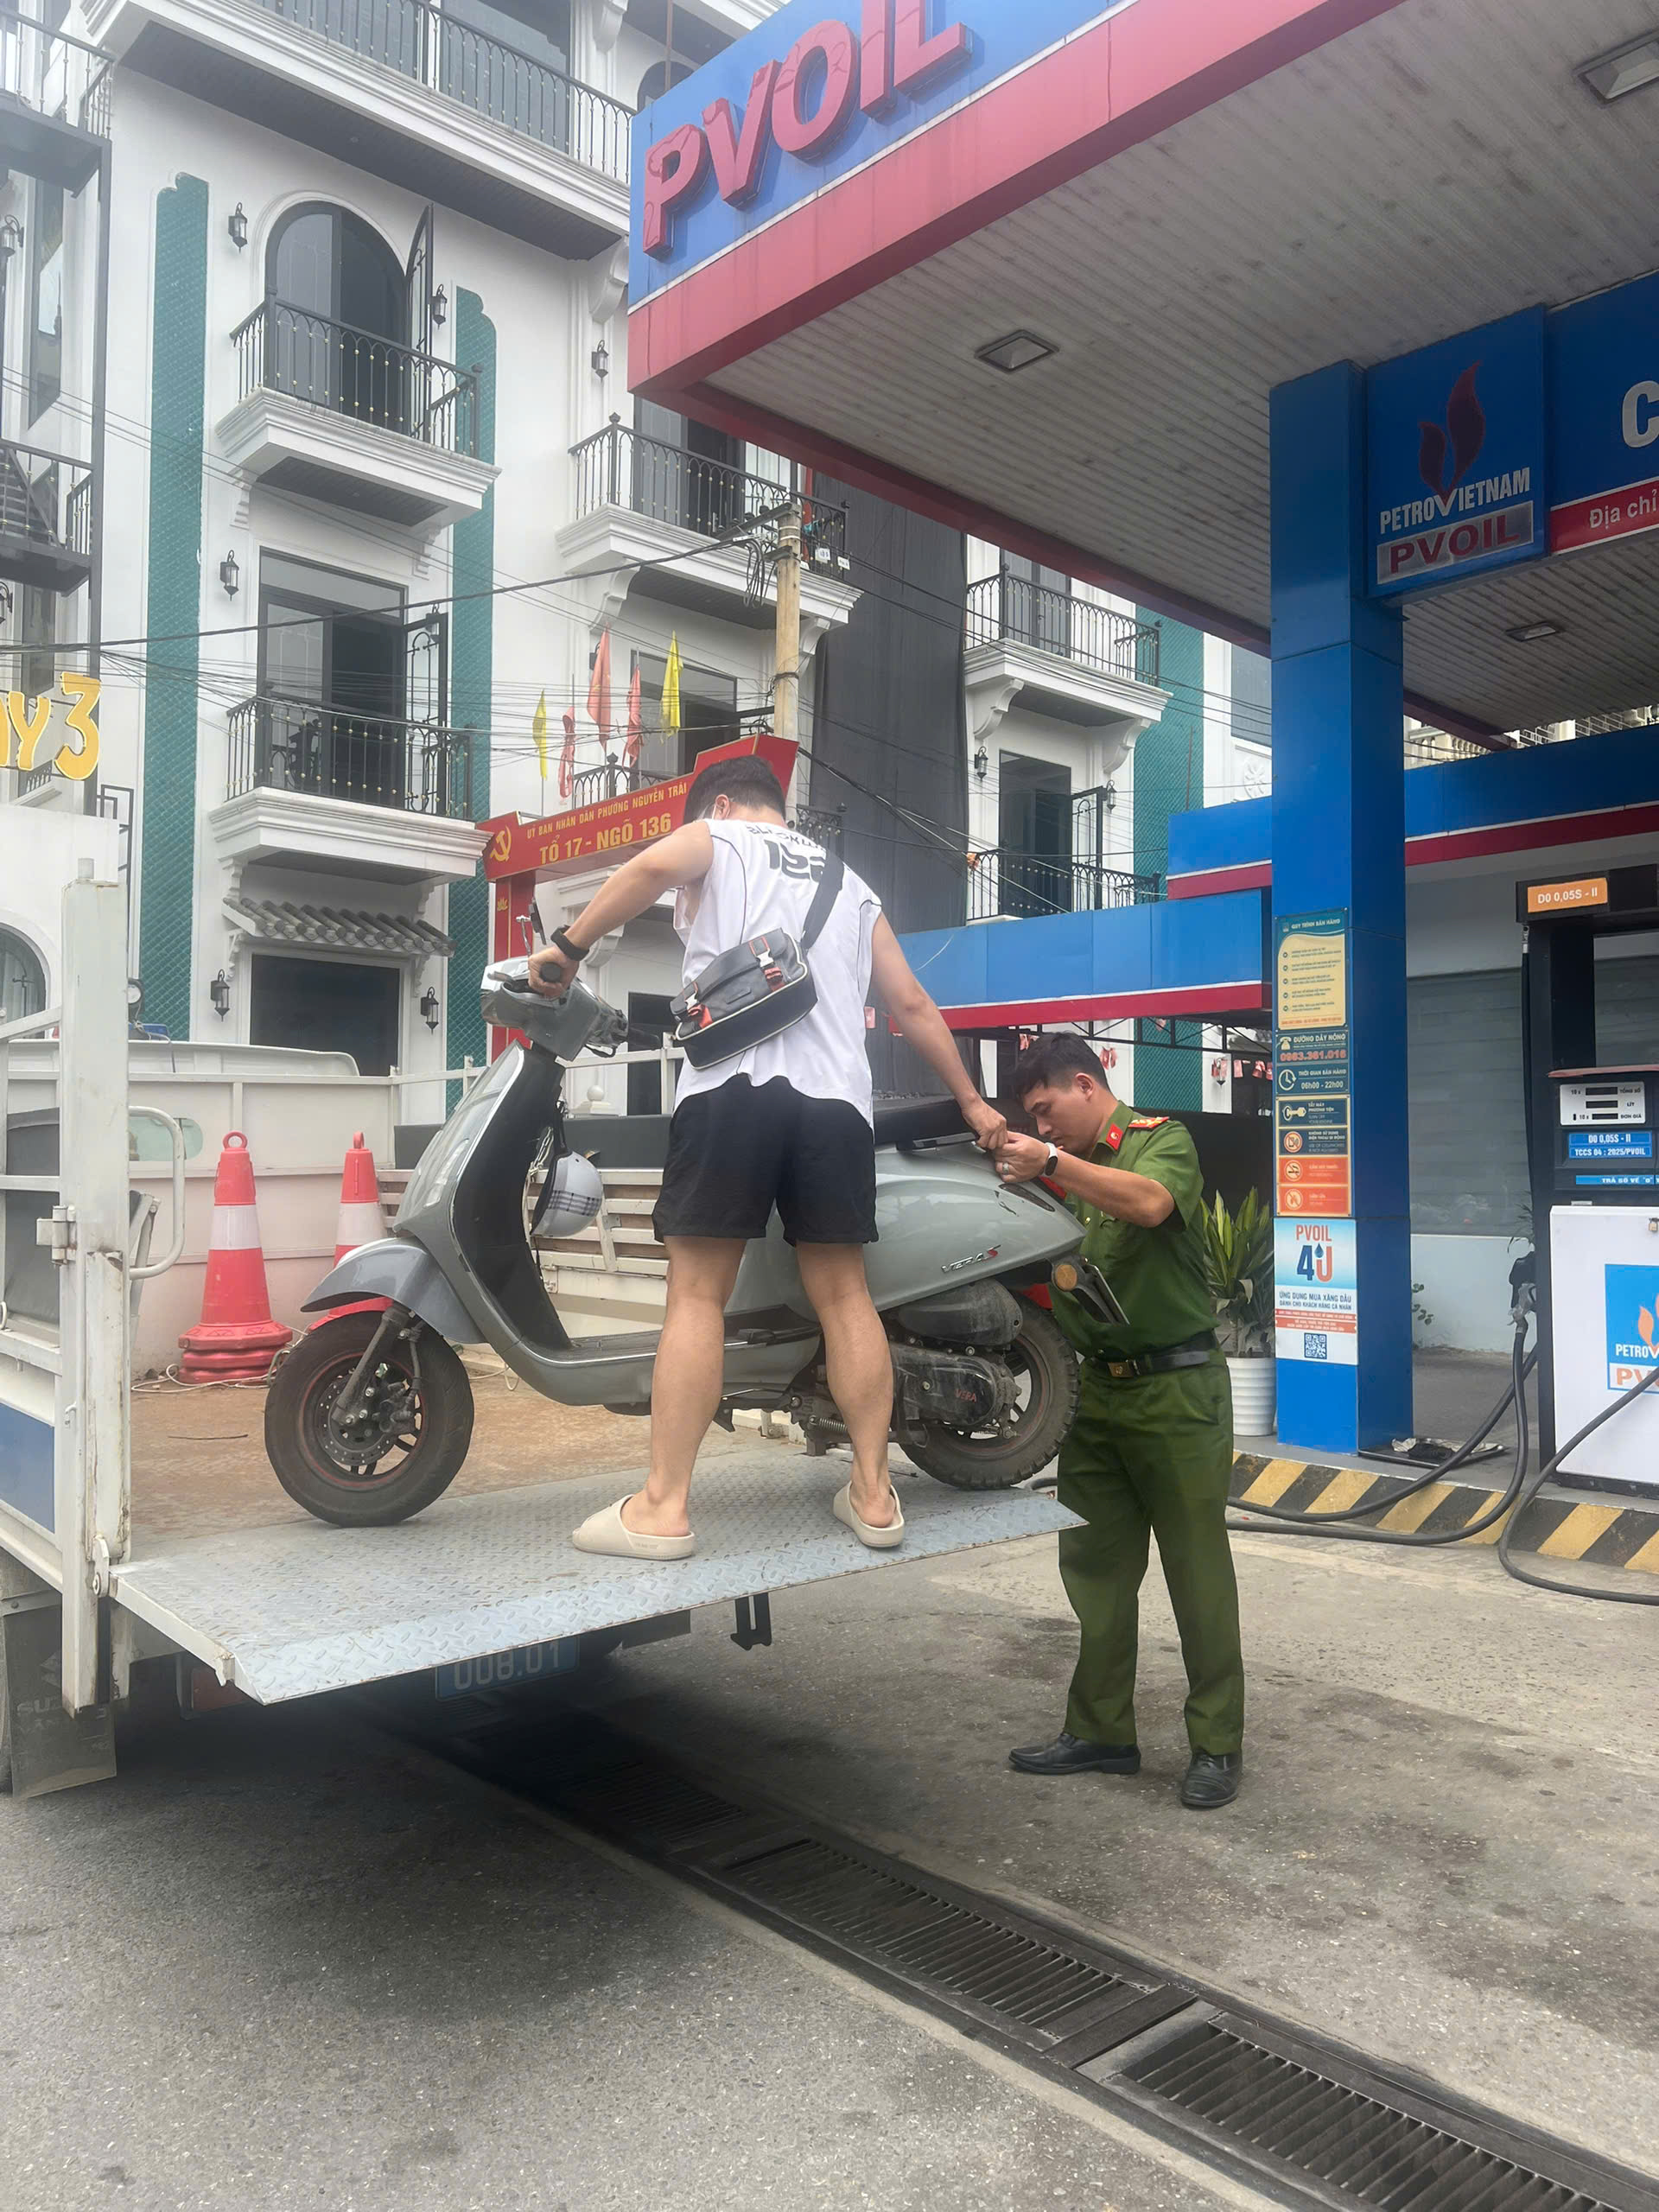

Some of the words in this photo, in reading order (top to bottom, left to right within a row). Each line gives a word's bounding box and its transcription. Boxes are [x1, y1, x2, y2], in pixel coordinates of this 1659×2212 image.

[643, 0, 968, 257] PVOIL
[1380, 467, 1530, 534] PETROVIETNAM
[1590, 505, 1620, 530] Địa
[1627, 489, 1657, 518] chỉ
[1389, 515, 1520, 575] PVOIL
[54, 671, 102, 780] 3
[538, 823, 553, 836] BAN
[556, 816, 576, 830] NHÂN
[580, 810, 594, 823] DÂN
[632, 787, 664, 808] NGUYỄN
[539, 834, 560, 865] TỔ
[565, 837, 582, 858] 17
[596, 817, 633, 850] NGÕ
[639, 812, 671, 838] 136
[1554, 889, 1582, 902] 0,05S
[1295, 1224, 1332, 1242] PVOIL
[955, 1389, 977, 1403] VERA
